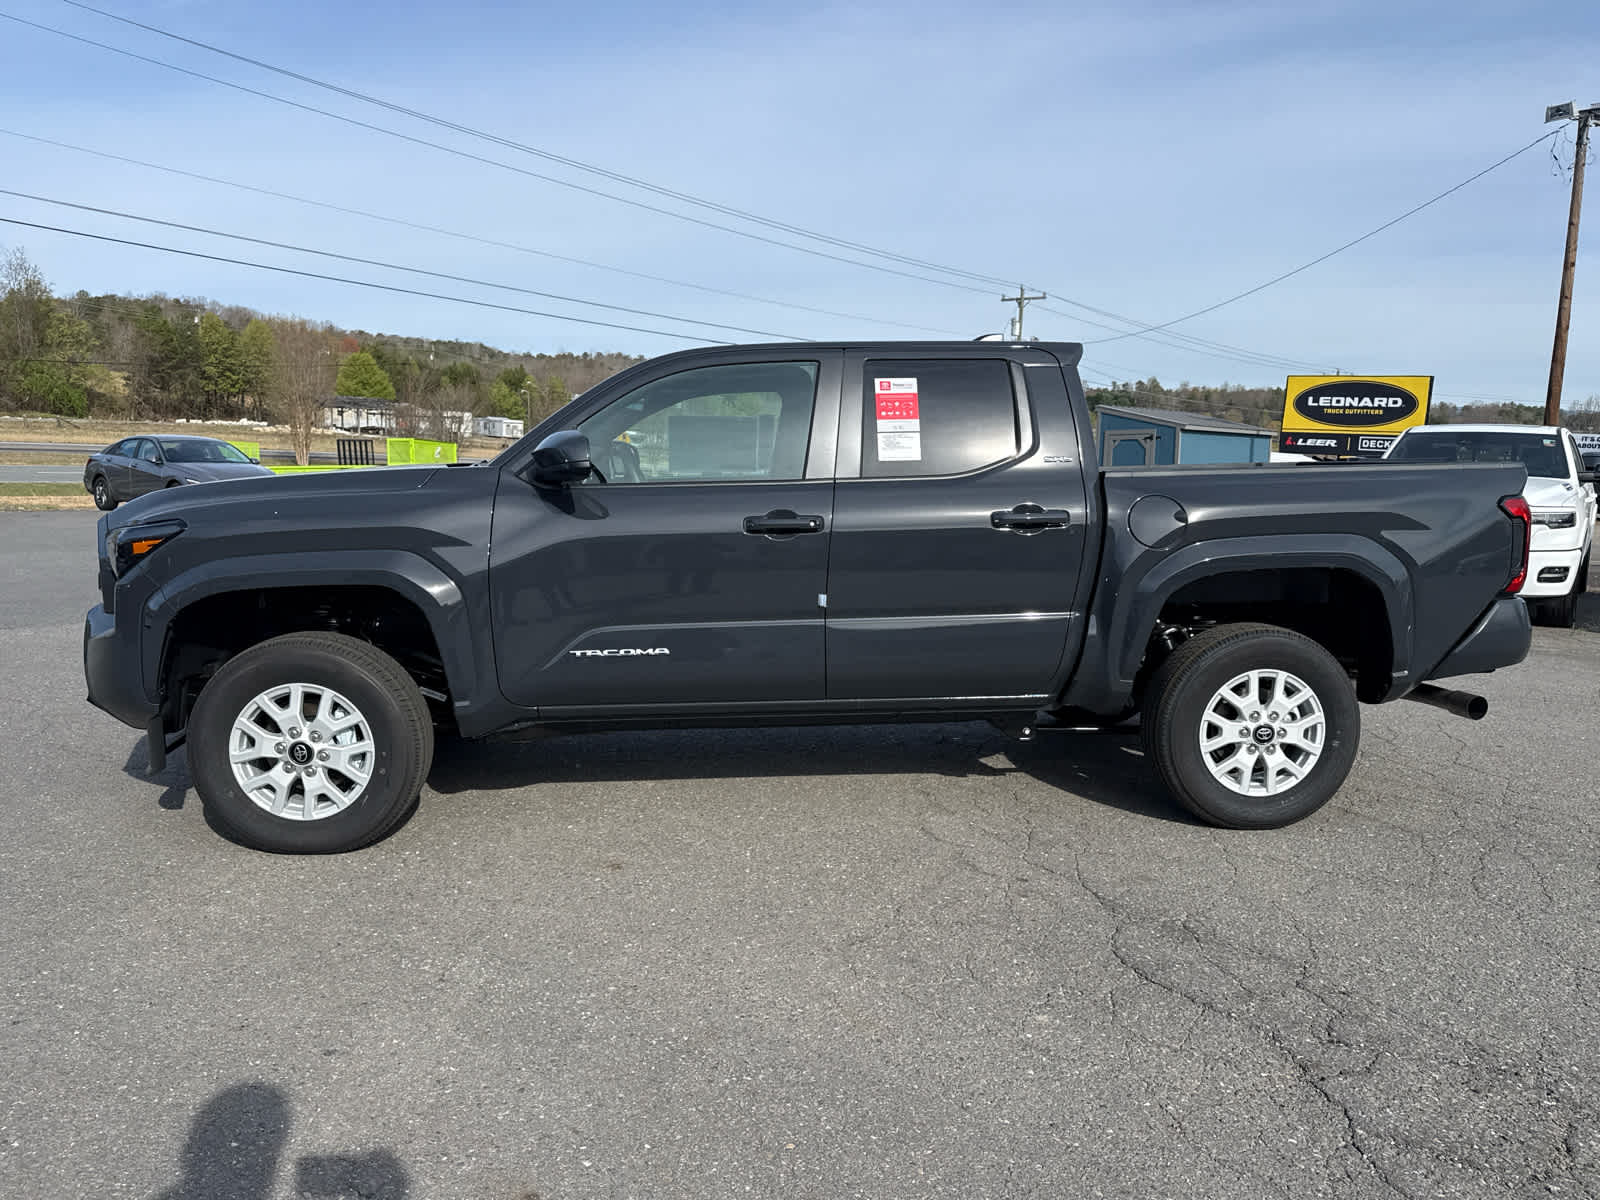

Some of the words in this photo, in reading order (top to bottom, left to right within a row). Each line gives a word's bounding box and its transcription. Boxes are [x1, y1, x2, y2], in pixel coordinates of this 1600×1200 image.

[1308, 396, 1403, 408] LEONARD
[1296, 438, 1338, 447] LEER
[569, 647, 670, 657] TACOMA
